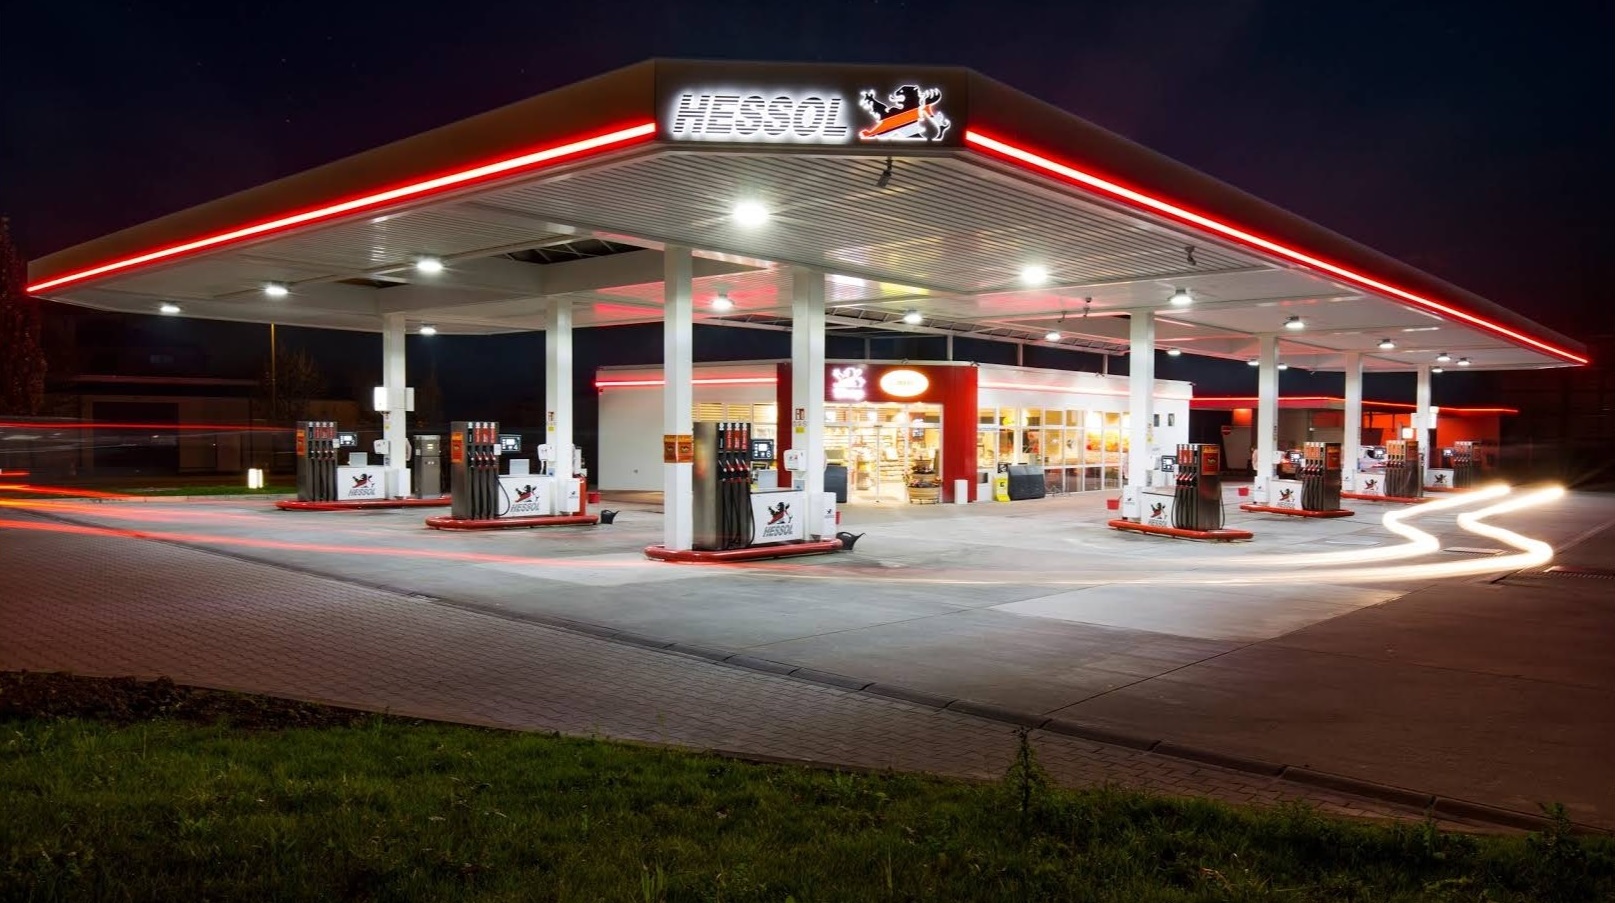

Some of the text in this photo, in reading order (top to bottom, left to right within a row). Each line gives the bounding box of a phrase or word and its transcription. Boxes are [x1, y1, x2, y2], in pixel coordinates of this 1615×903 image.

[672, 93, 848, 137] HESSOL
[348, 488, 376, 497] HESSOL
[510, 502, 540, 513] HESSOL
[763, 524, 794, 537] HESSOL
